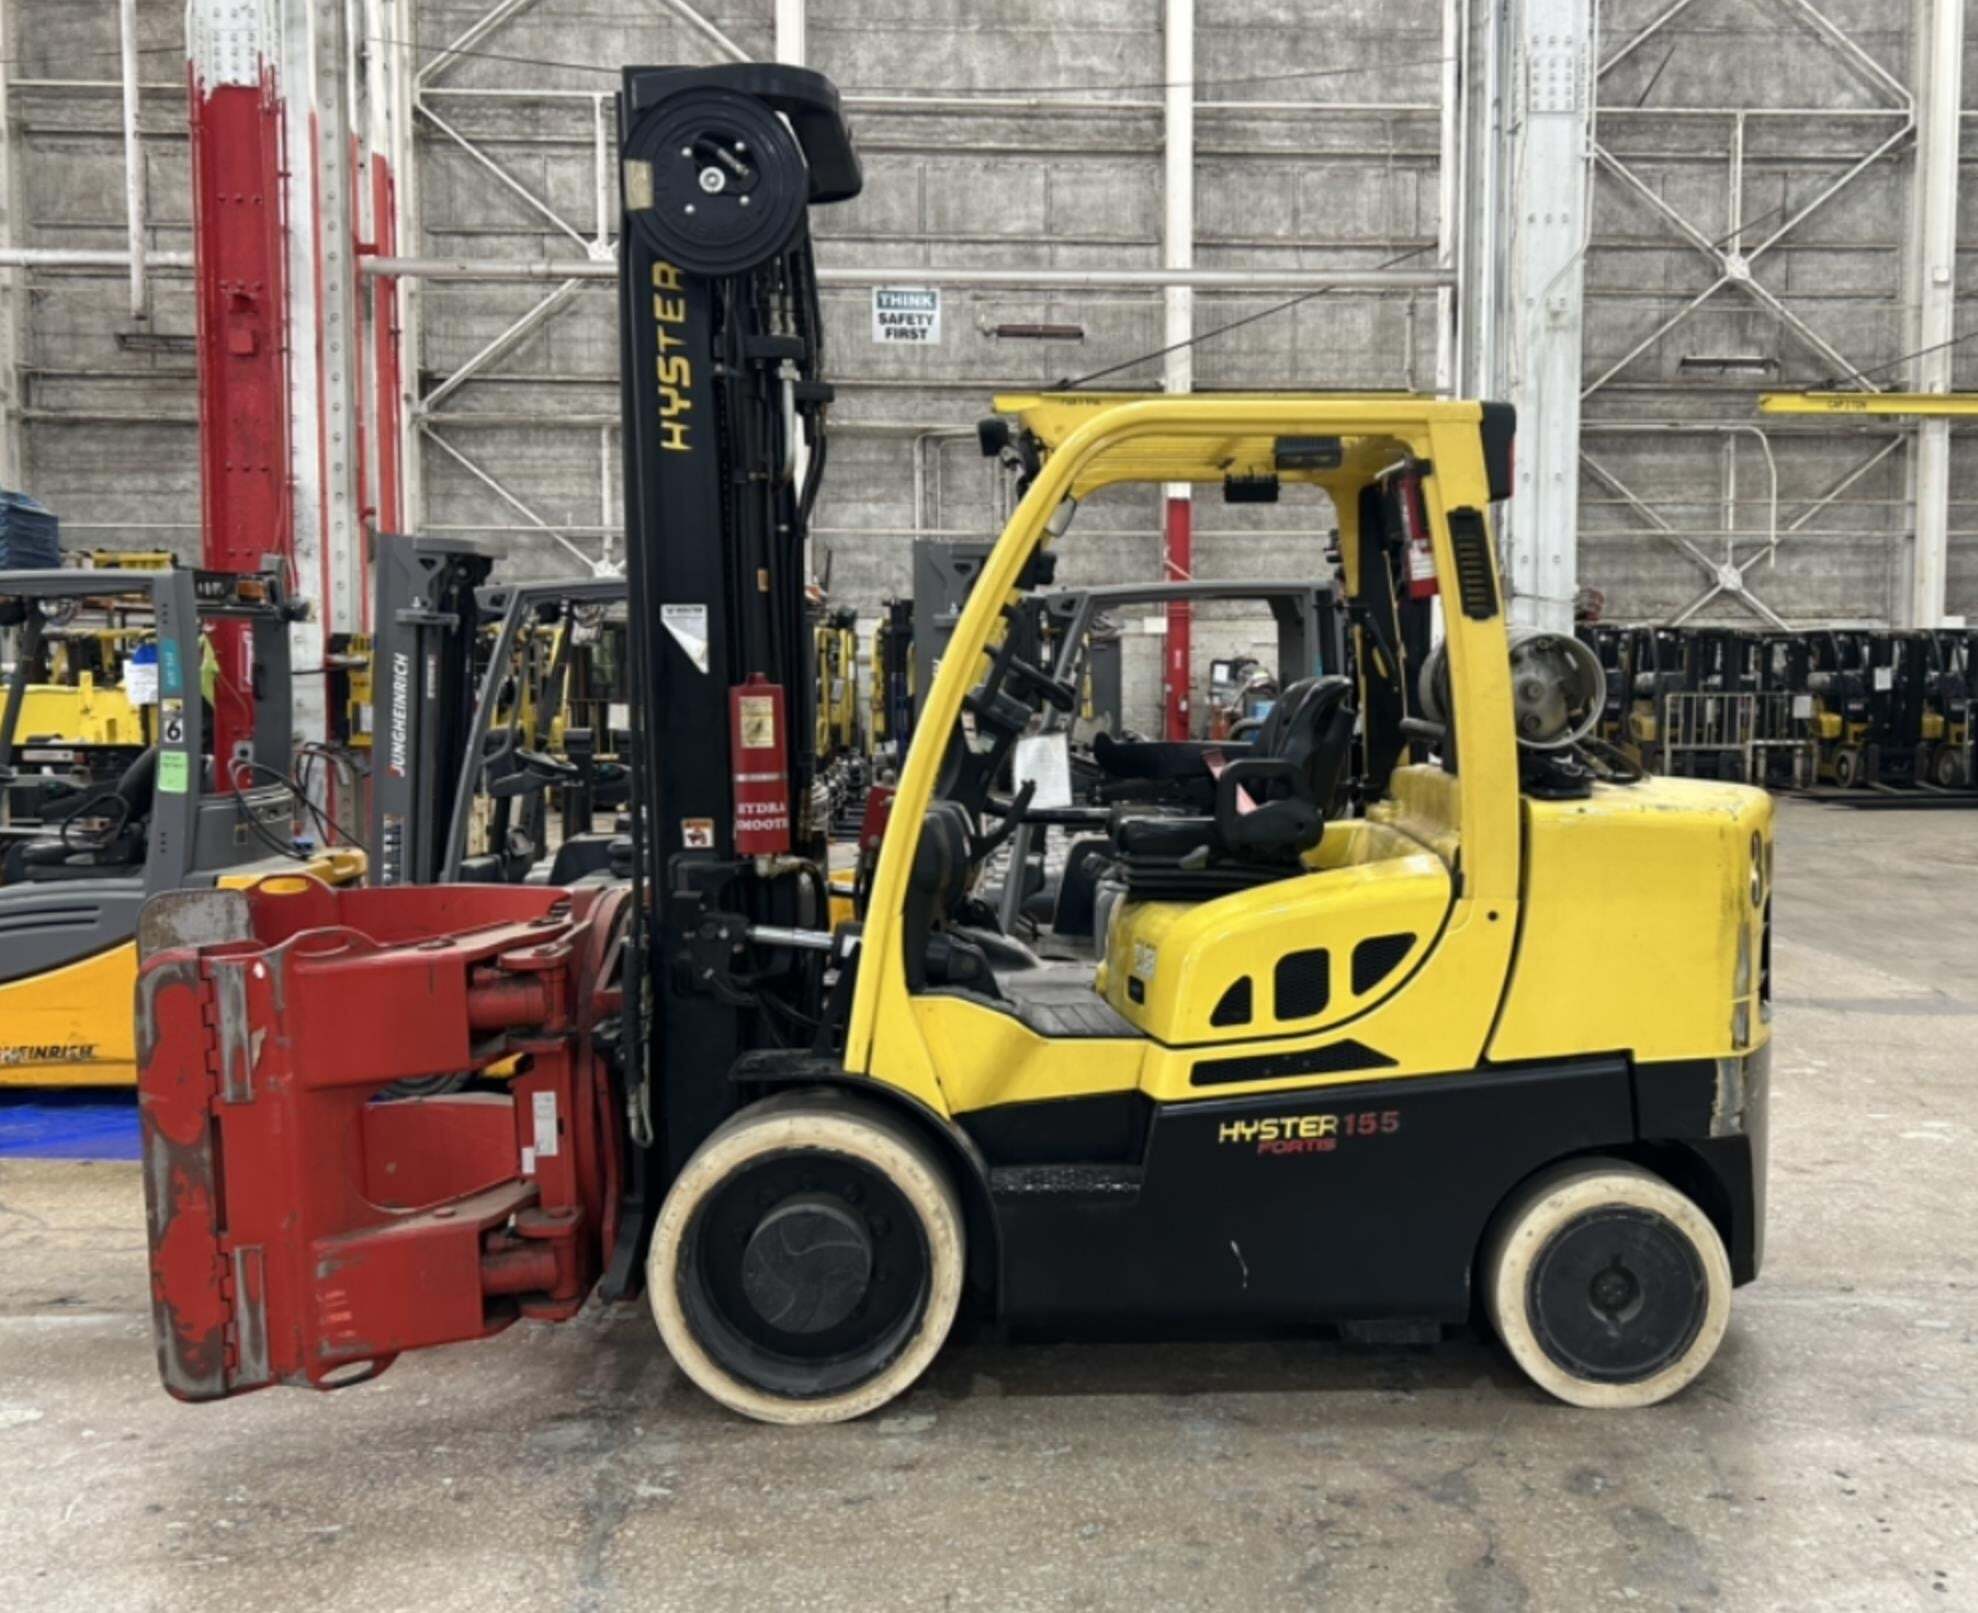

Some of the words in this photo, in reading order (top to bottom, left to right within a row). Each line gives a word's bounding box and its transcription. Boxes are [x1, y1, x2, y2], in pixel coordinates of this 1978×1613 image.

[880, 293, 933, 307] THINK
[879, 312, 934, 326] SAFETY
[885, 326, 928, 340] FIRST
[652, 260, 693, 450] HYSTER
[391, 652, 409, 778] JUNGHEINRICH
[167, 720, 181, 741] 6
[1218, 1114, 1339, 1143] HYSTER
[1344, 1111, 1400, 1136] 155
[1257, 1137, 1337, 1155] FORTIS
